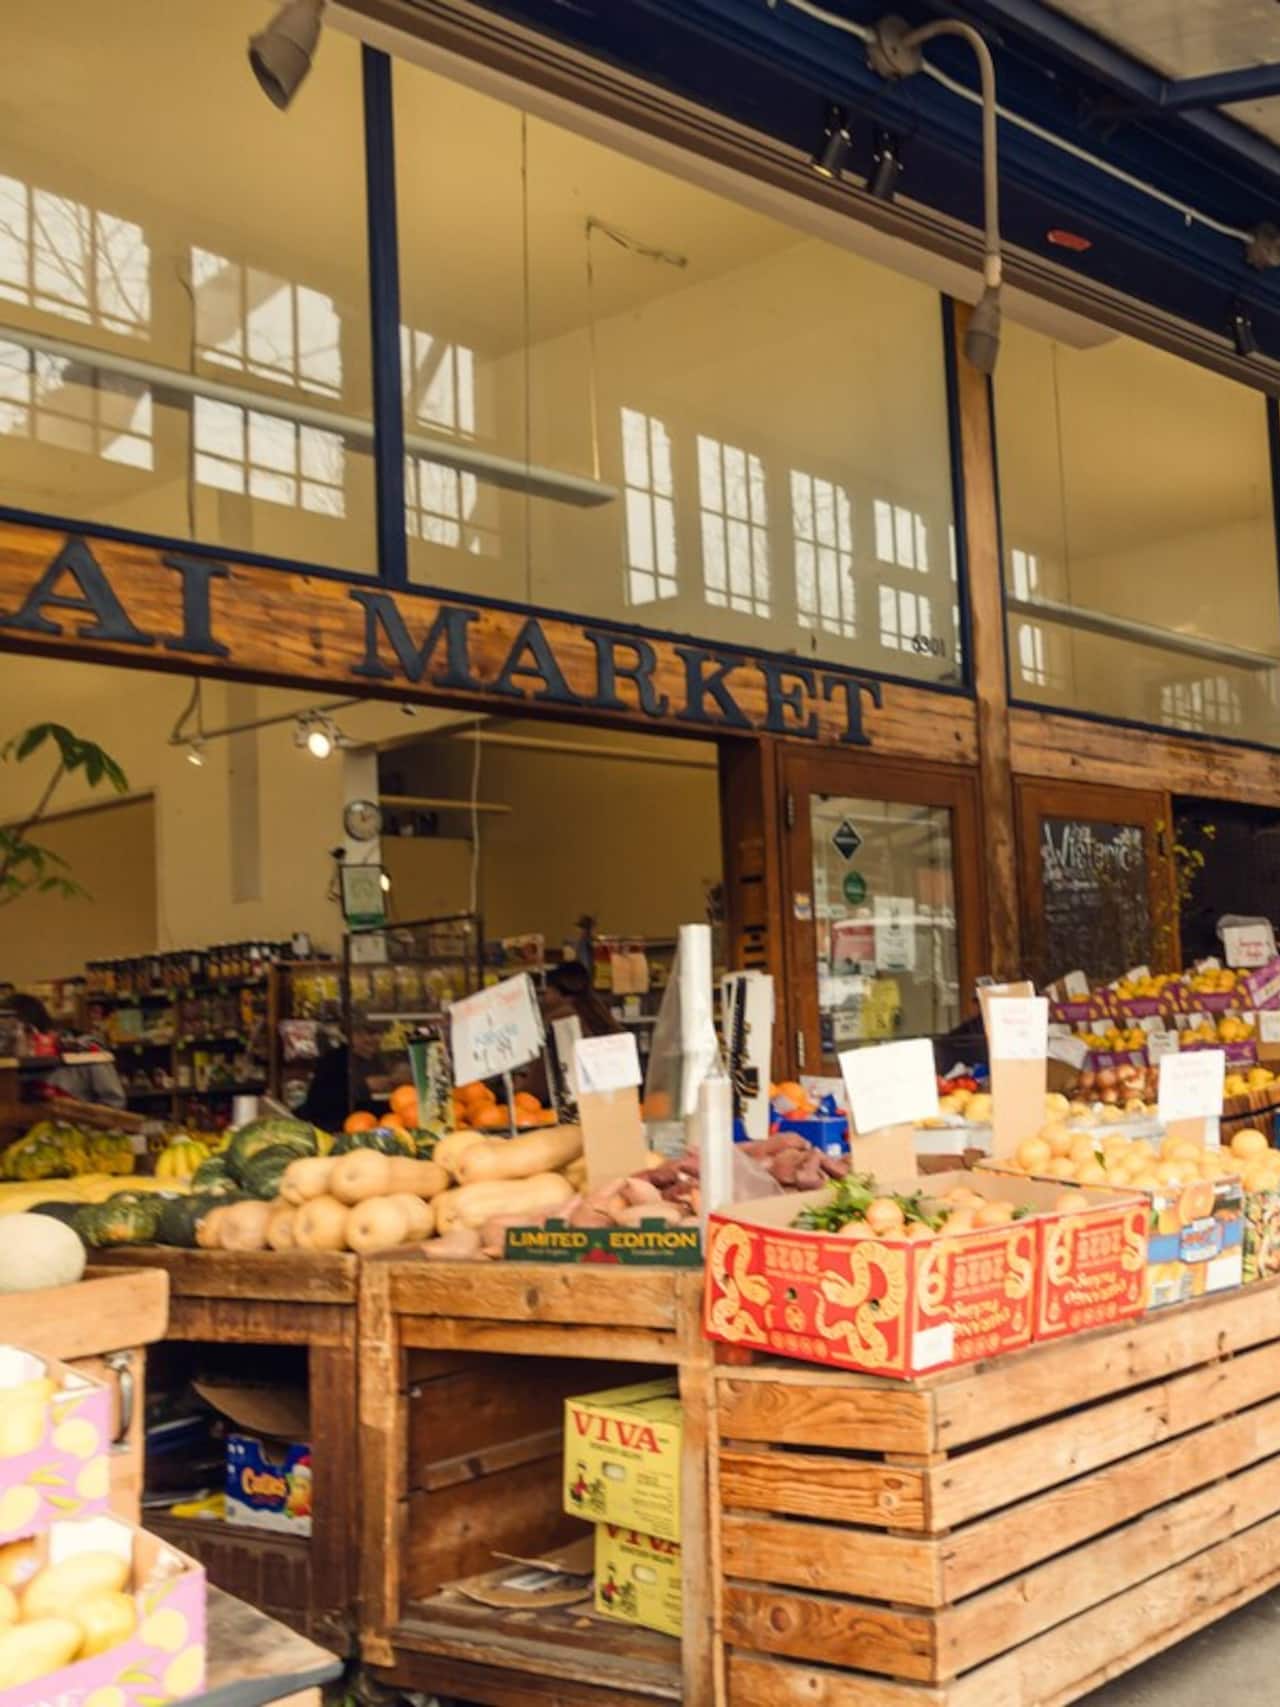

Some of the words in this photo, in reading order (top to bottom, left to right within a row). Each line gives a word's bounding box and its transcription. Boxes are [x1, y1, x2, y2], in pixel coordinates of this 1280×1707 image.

[0, 534, 231, 658] AI
[349, 588, 882, 747] MARKET
[509, 1232, 588, 1248] LIMITED
[608, 1232, 697, 1248] EDITION
[571, 1409, 662, 1455] VIVA
[605, 1523, 682, 1557] VIV
